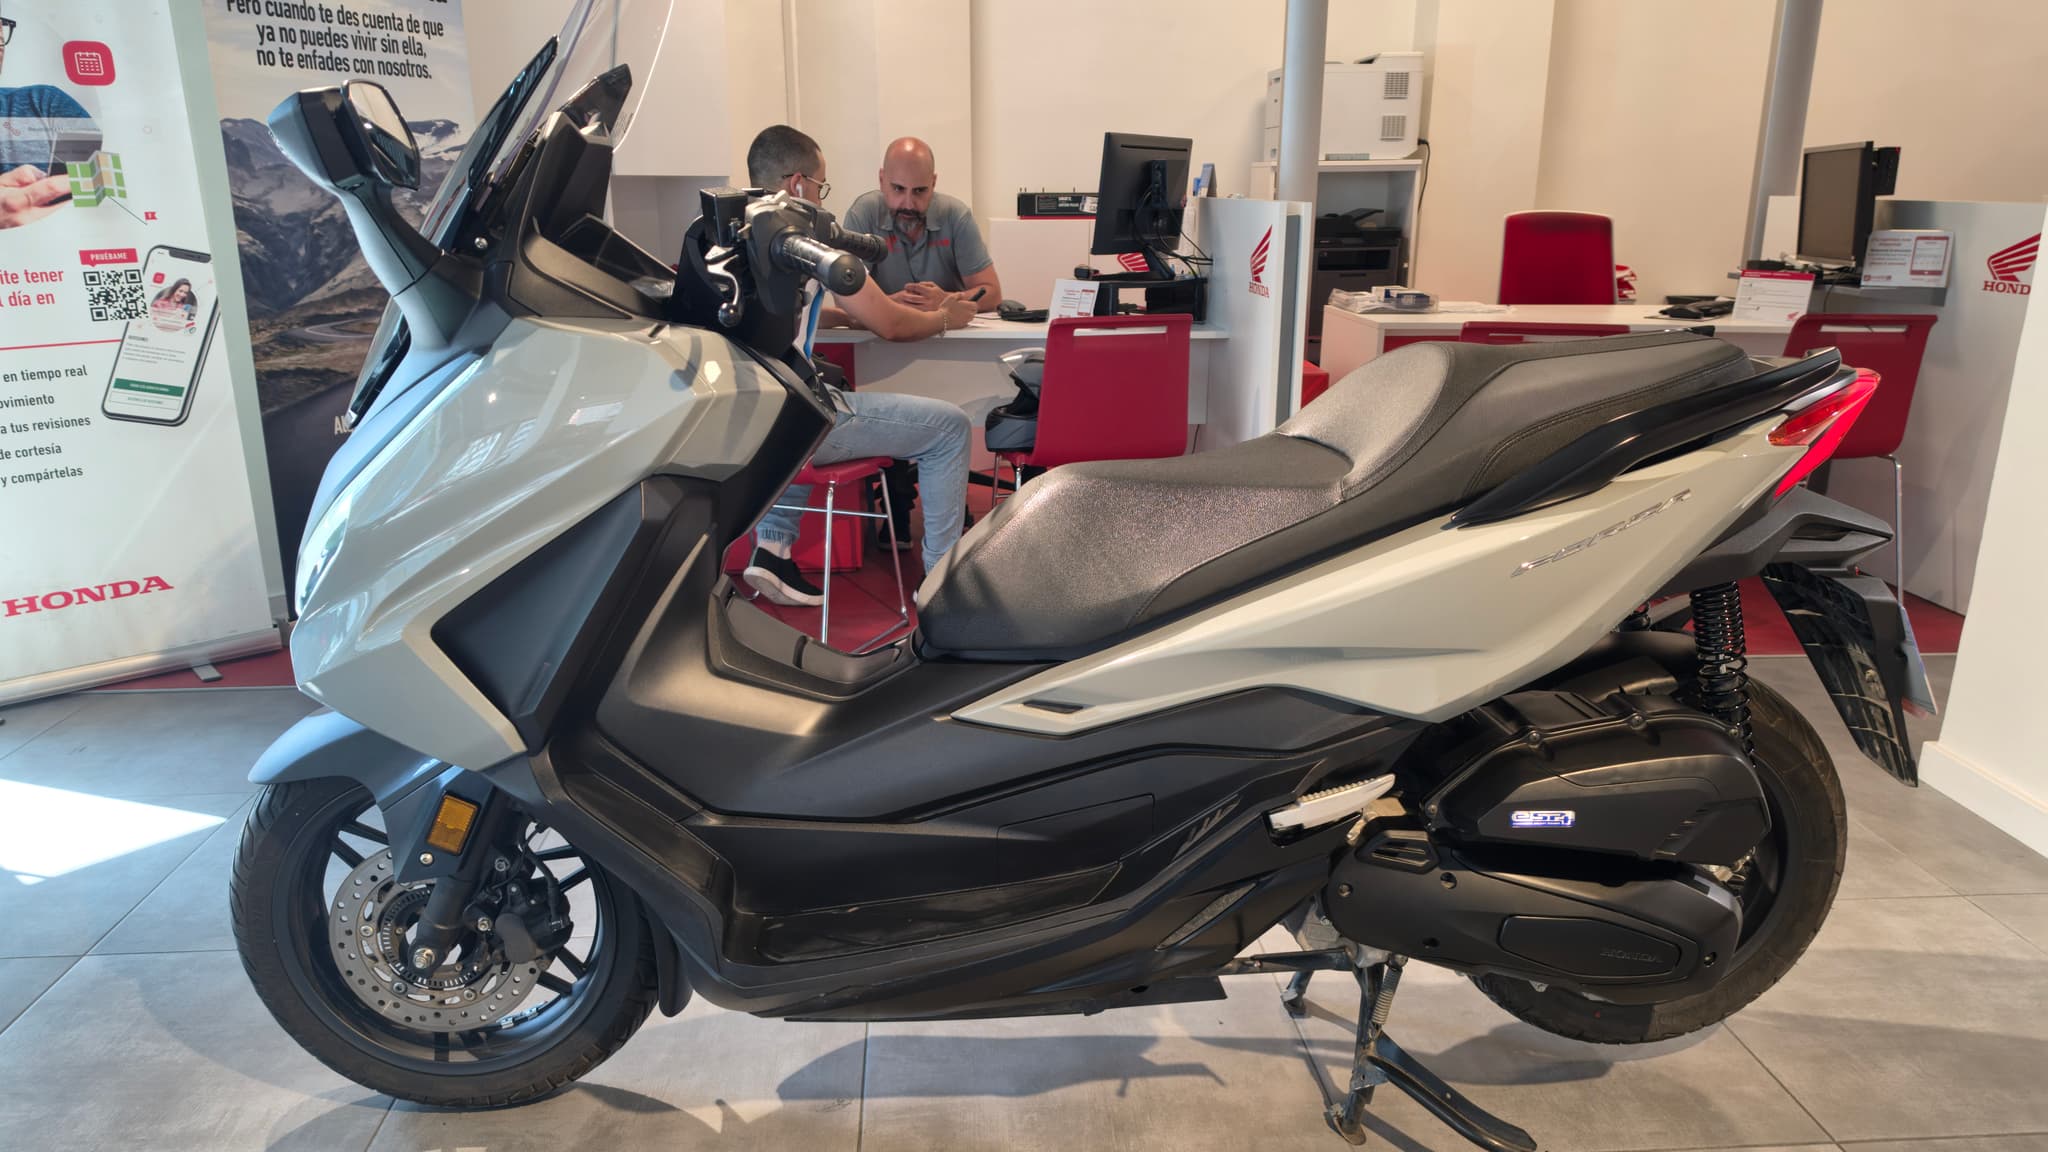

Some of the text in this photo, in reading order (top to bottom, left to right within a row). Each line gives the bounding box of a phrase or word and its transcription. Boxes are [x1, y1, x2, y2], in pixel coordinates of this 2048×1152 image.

[227, 0, 444, 38] Pero cuando te des cuenta de que
[256, 23, 427, 59] ya no puedes vivir sin ella,
[257, 48, 432, 79] no te enfades con nosotros.
[24, 268, 64, 284] tener
[1249, 281, 1270, 298] HONDA
[1982, 280, 2031, 295] HOND
[8, 290, 32, 307] día
[36, 293, 56, 305] en
[3, 364, 88, 383] en tiempo real
[10, 422, 30, 433] tus
[32, 417, 91, 432] revisiones
[15, 443, 62, 459] cortesía
[0, 466, 84, 488] y compártelas
[2, 575, 174, 617] HONDA
